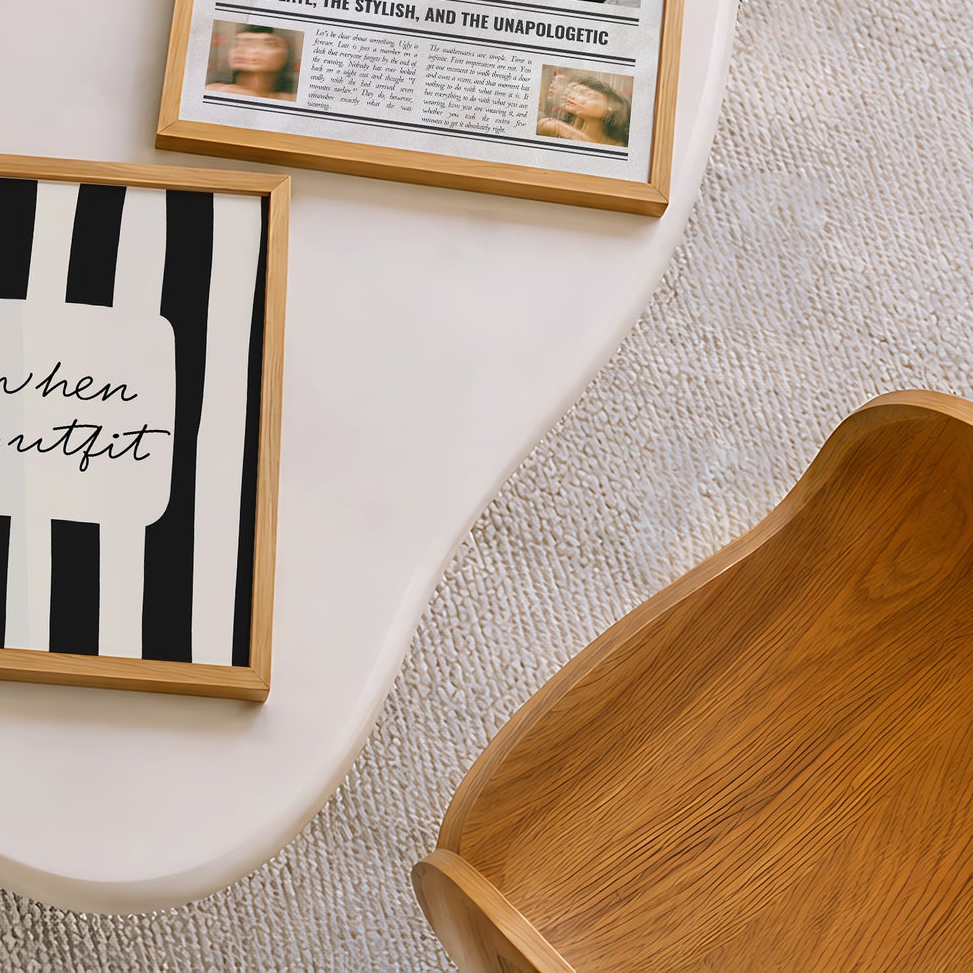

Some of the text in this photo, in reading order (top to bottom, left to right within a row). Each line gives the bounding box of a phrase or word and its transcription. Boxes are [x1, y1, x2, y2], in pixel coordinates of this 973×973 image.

[424, 7, 456, 24] AND
[461, 12, 489, 29] THE
[493, 16, 609, 45] UNAPOLOGETIC
[329, 30, 337, 39] be
[398, 39, 413, 51] Ugly
[337, 40, 350, 49] Late
[429, 44, 440, 52] The
[347, 60, 370, 72] Nobody
[520, 65, 532, 73] You
[517, 74, 531, 82] door
[361, 88, 374, 99] They
